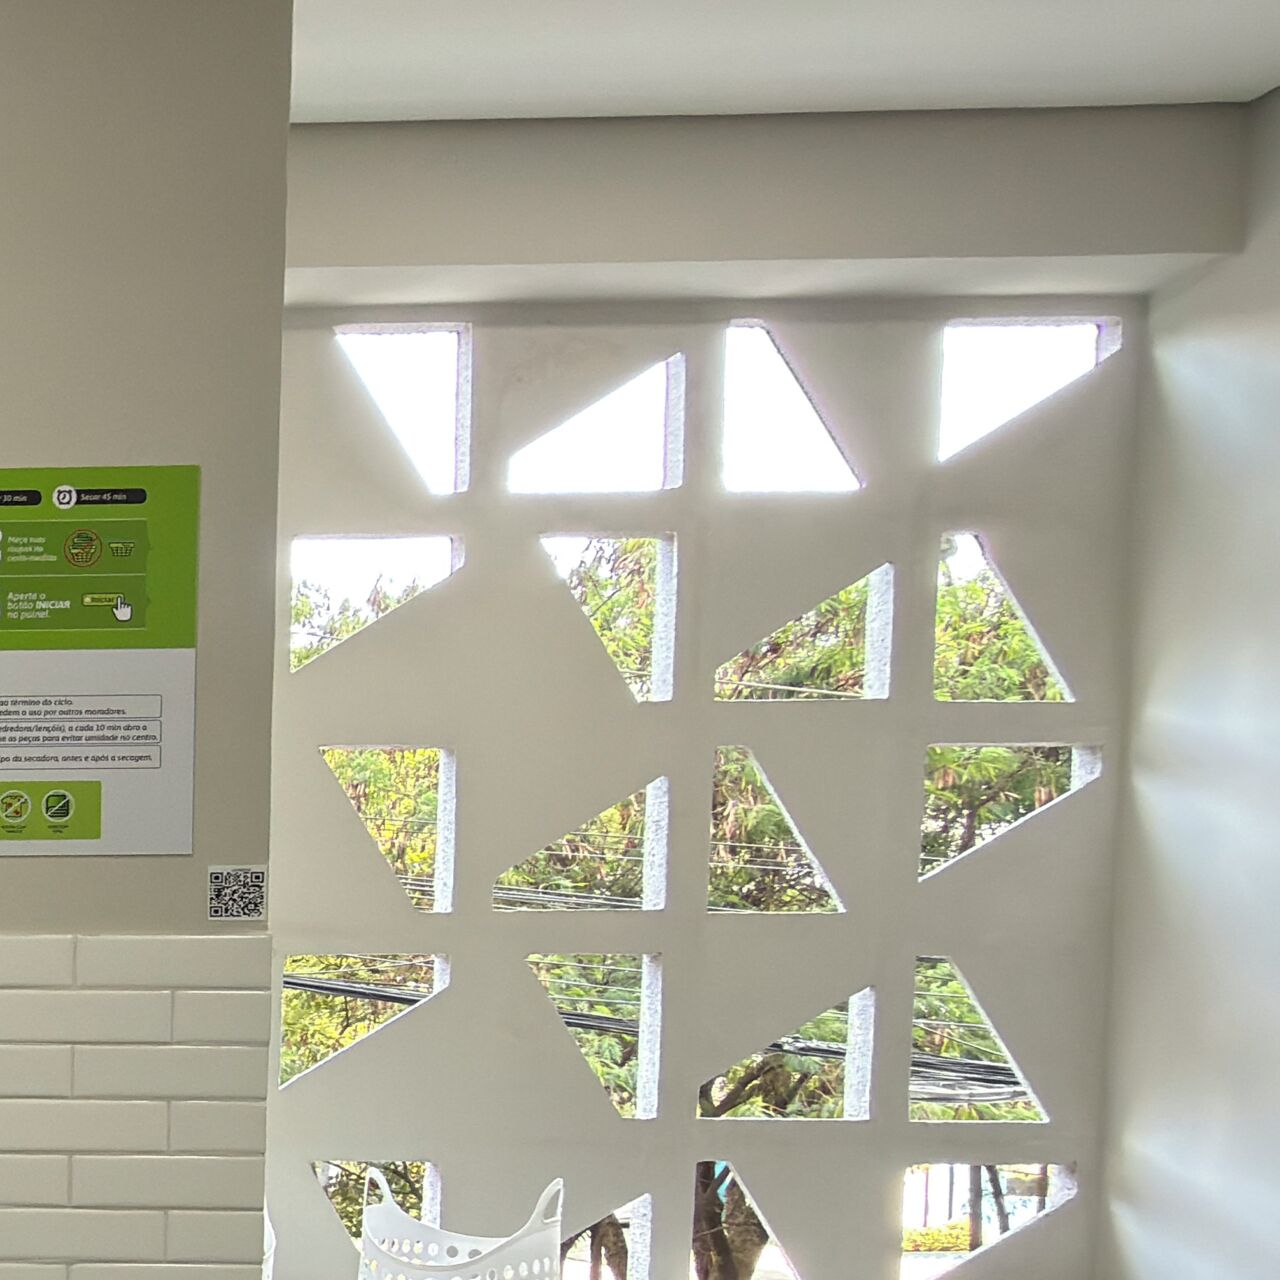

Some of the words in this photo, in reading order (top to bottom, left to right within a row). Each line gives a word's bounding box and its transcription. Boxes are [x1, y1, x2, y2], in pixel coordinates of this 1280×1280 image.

[80, 493, 101, 501] Secar
[101, 492, 111, 500] 45
[35, 600, 70, 609] INICIAR
